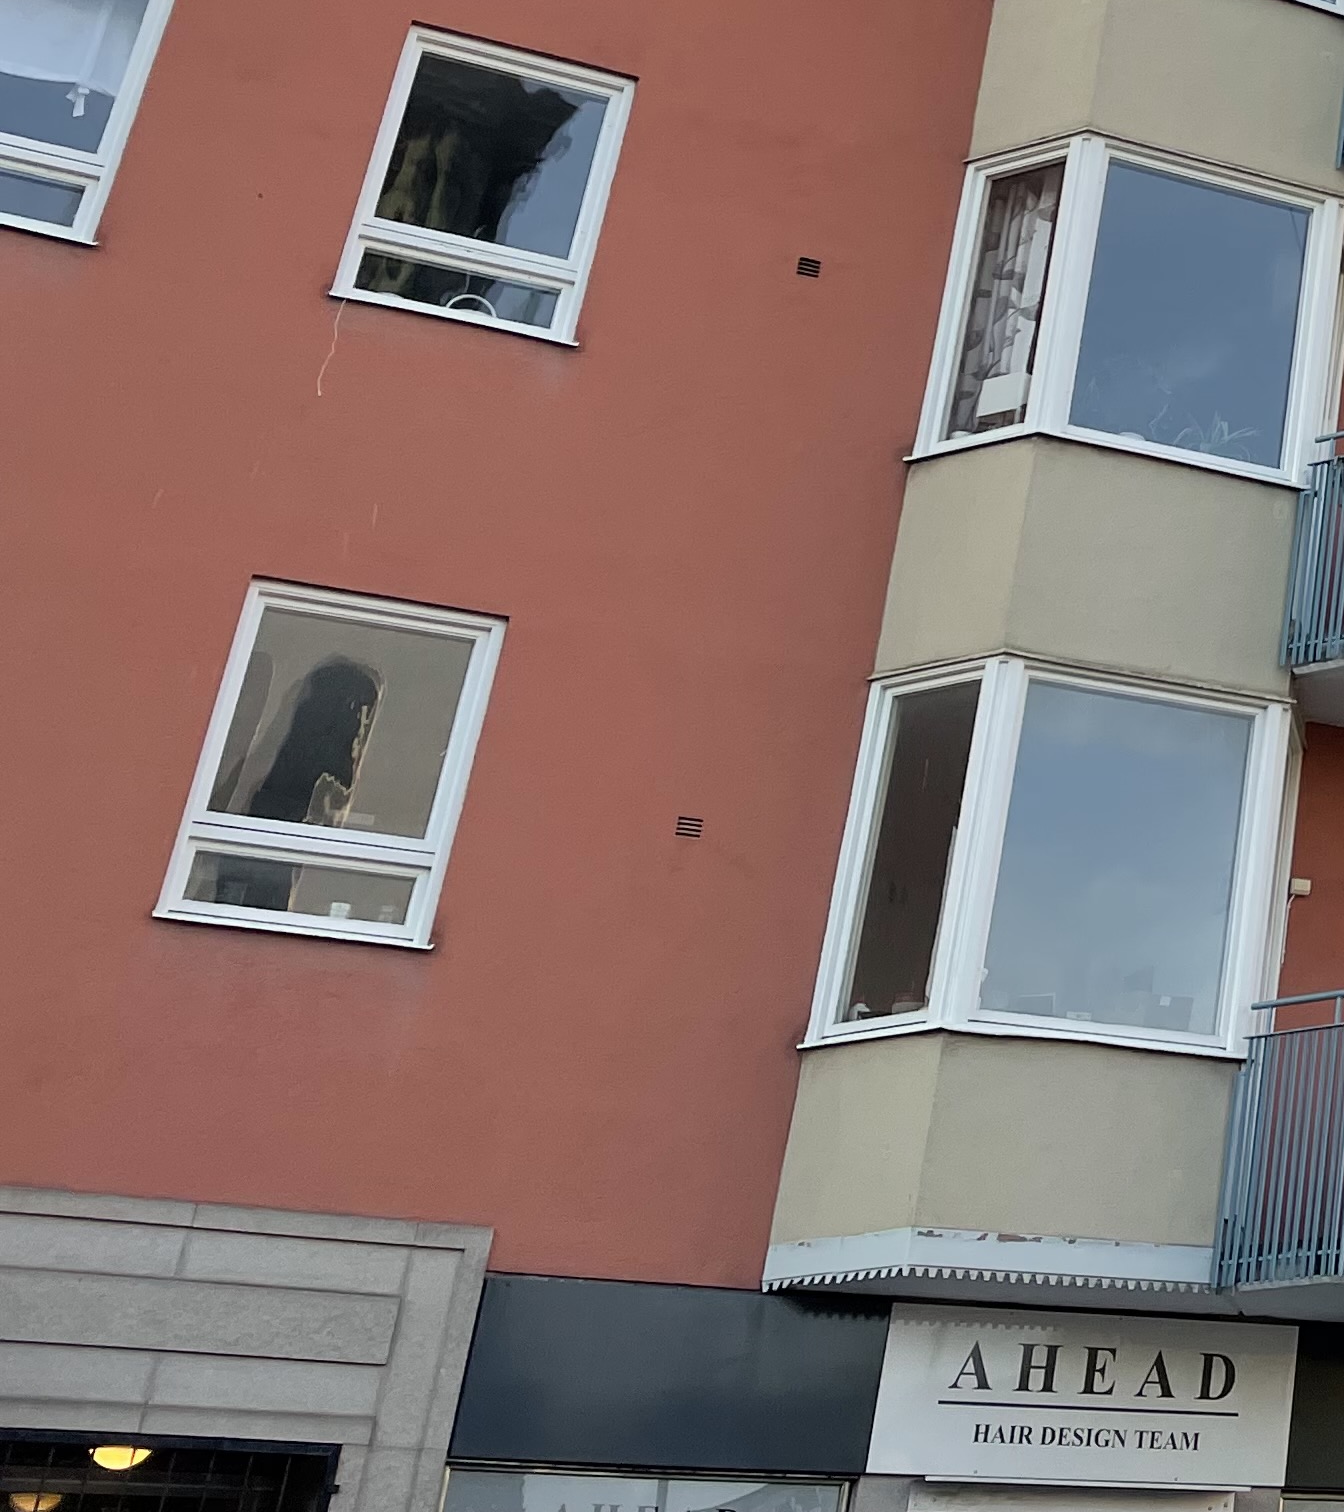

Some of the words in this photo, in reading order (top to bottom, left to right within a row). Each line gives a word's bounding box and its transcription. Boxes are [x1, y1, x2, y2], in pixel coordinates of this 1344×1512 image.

[948, 1340, 1236, 1401] AHEAD
[973, 1423, 1032, 1446] HAIR
[1040, 1425, 1127, 1450] DESIGN
[1135, 1429, 1200, 1452] TEAM
